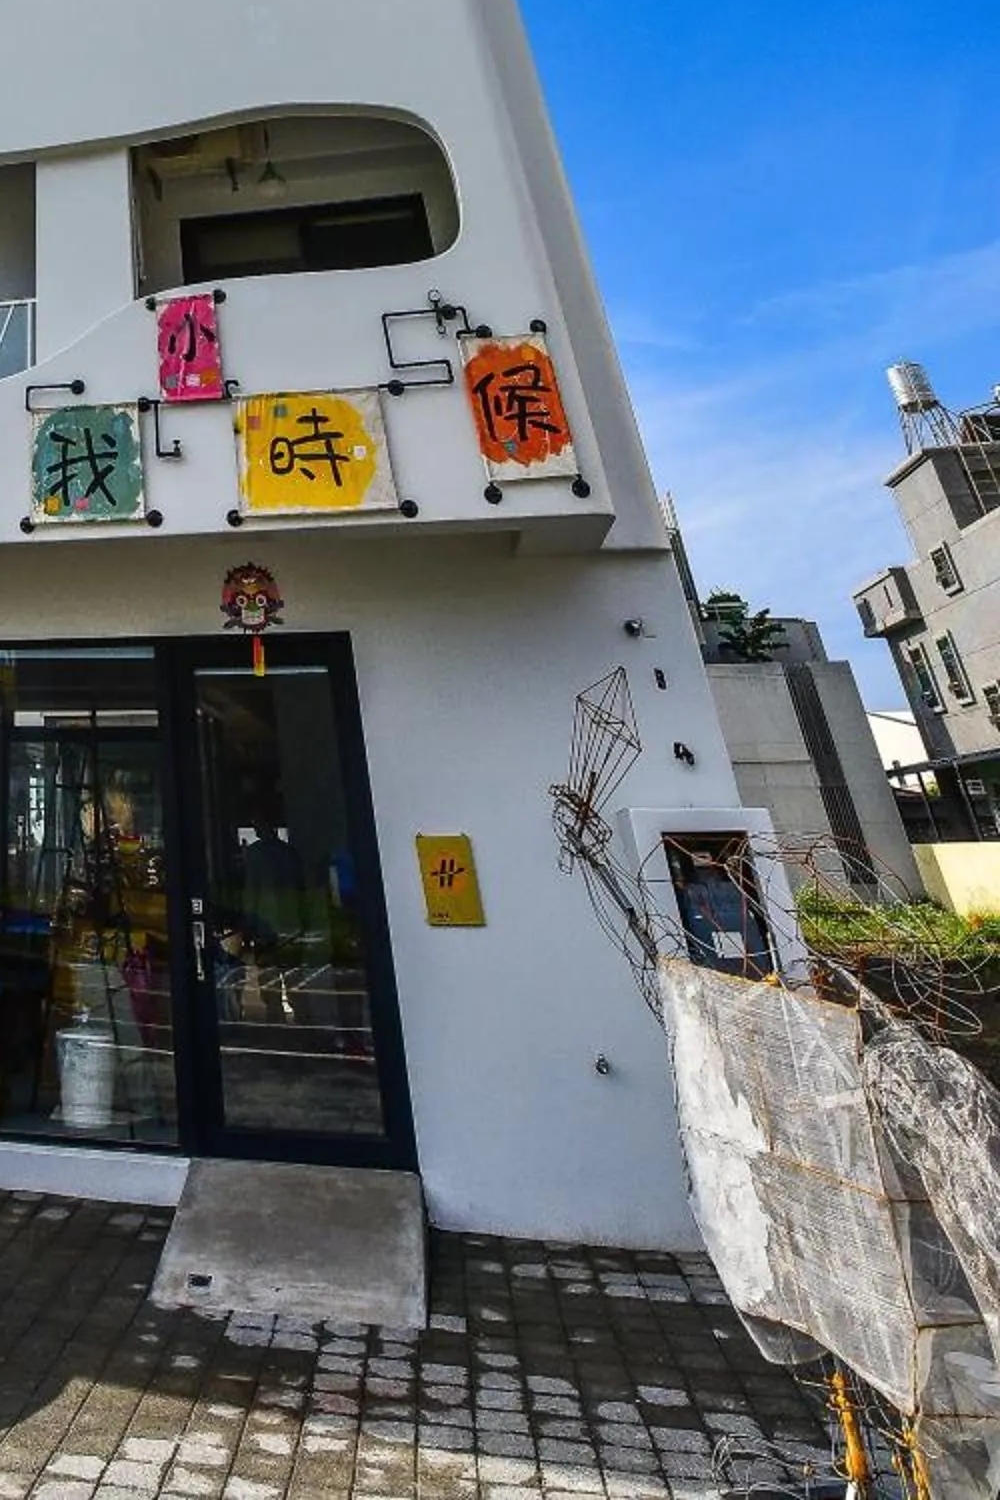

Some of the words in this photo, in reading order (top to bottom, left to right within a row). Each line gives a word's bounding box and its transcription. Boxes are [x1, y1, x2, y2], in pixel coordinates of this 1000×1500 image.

[168, 312, 217, 362] 小
[473, 363, 560, 443] 候
[48, 427, 119, 506] 我
[270, 408, 350, 487] 時
